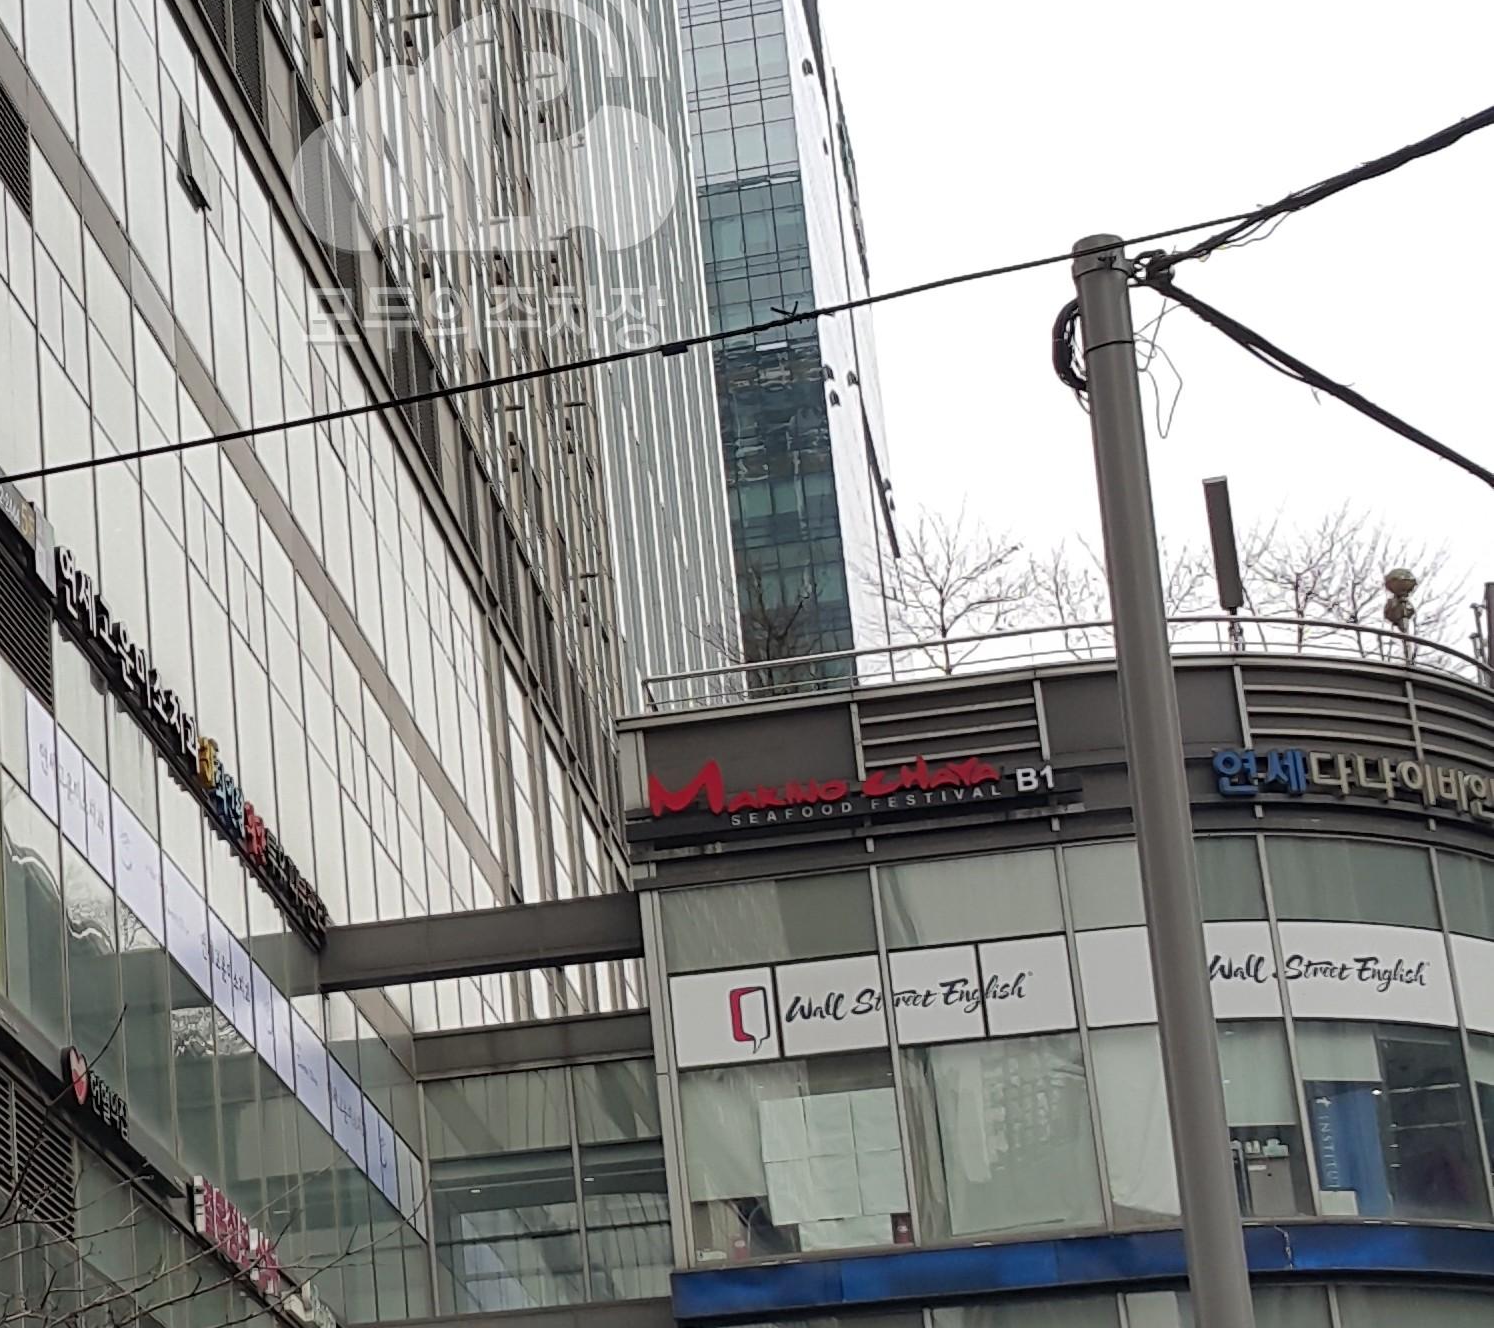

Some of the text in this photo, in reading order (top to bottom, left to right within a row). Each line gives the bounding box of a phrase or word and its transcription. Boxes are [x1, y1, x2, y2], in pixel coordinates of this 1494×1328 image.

[58, 545, 199, 775] 연세고운미소치과
[1015, 764, 1056, 793] B1
[731, 784, 1002, 827] SEAFOOD FESTIVAL
[1209, 953, 1427, 992] Wall Street English
[785, 972, 1028, 1025] Wall Street English
